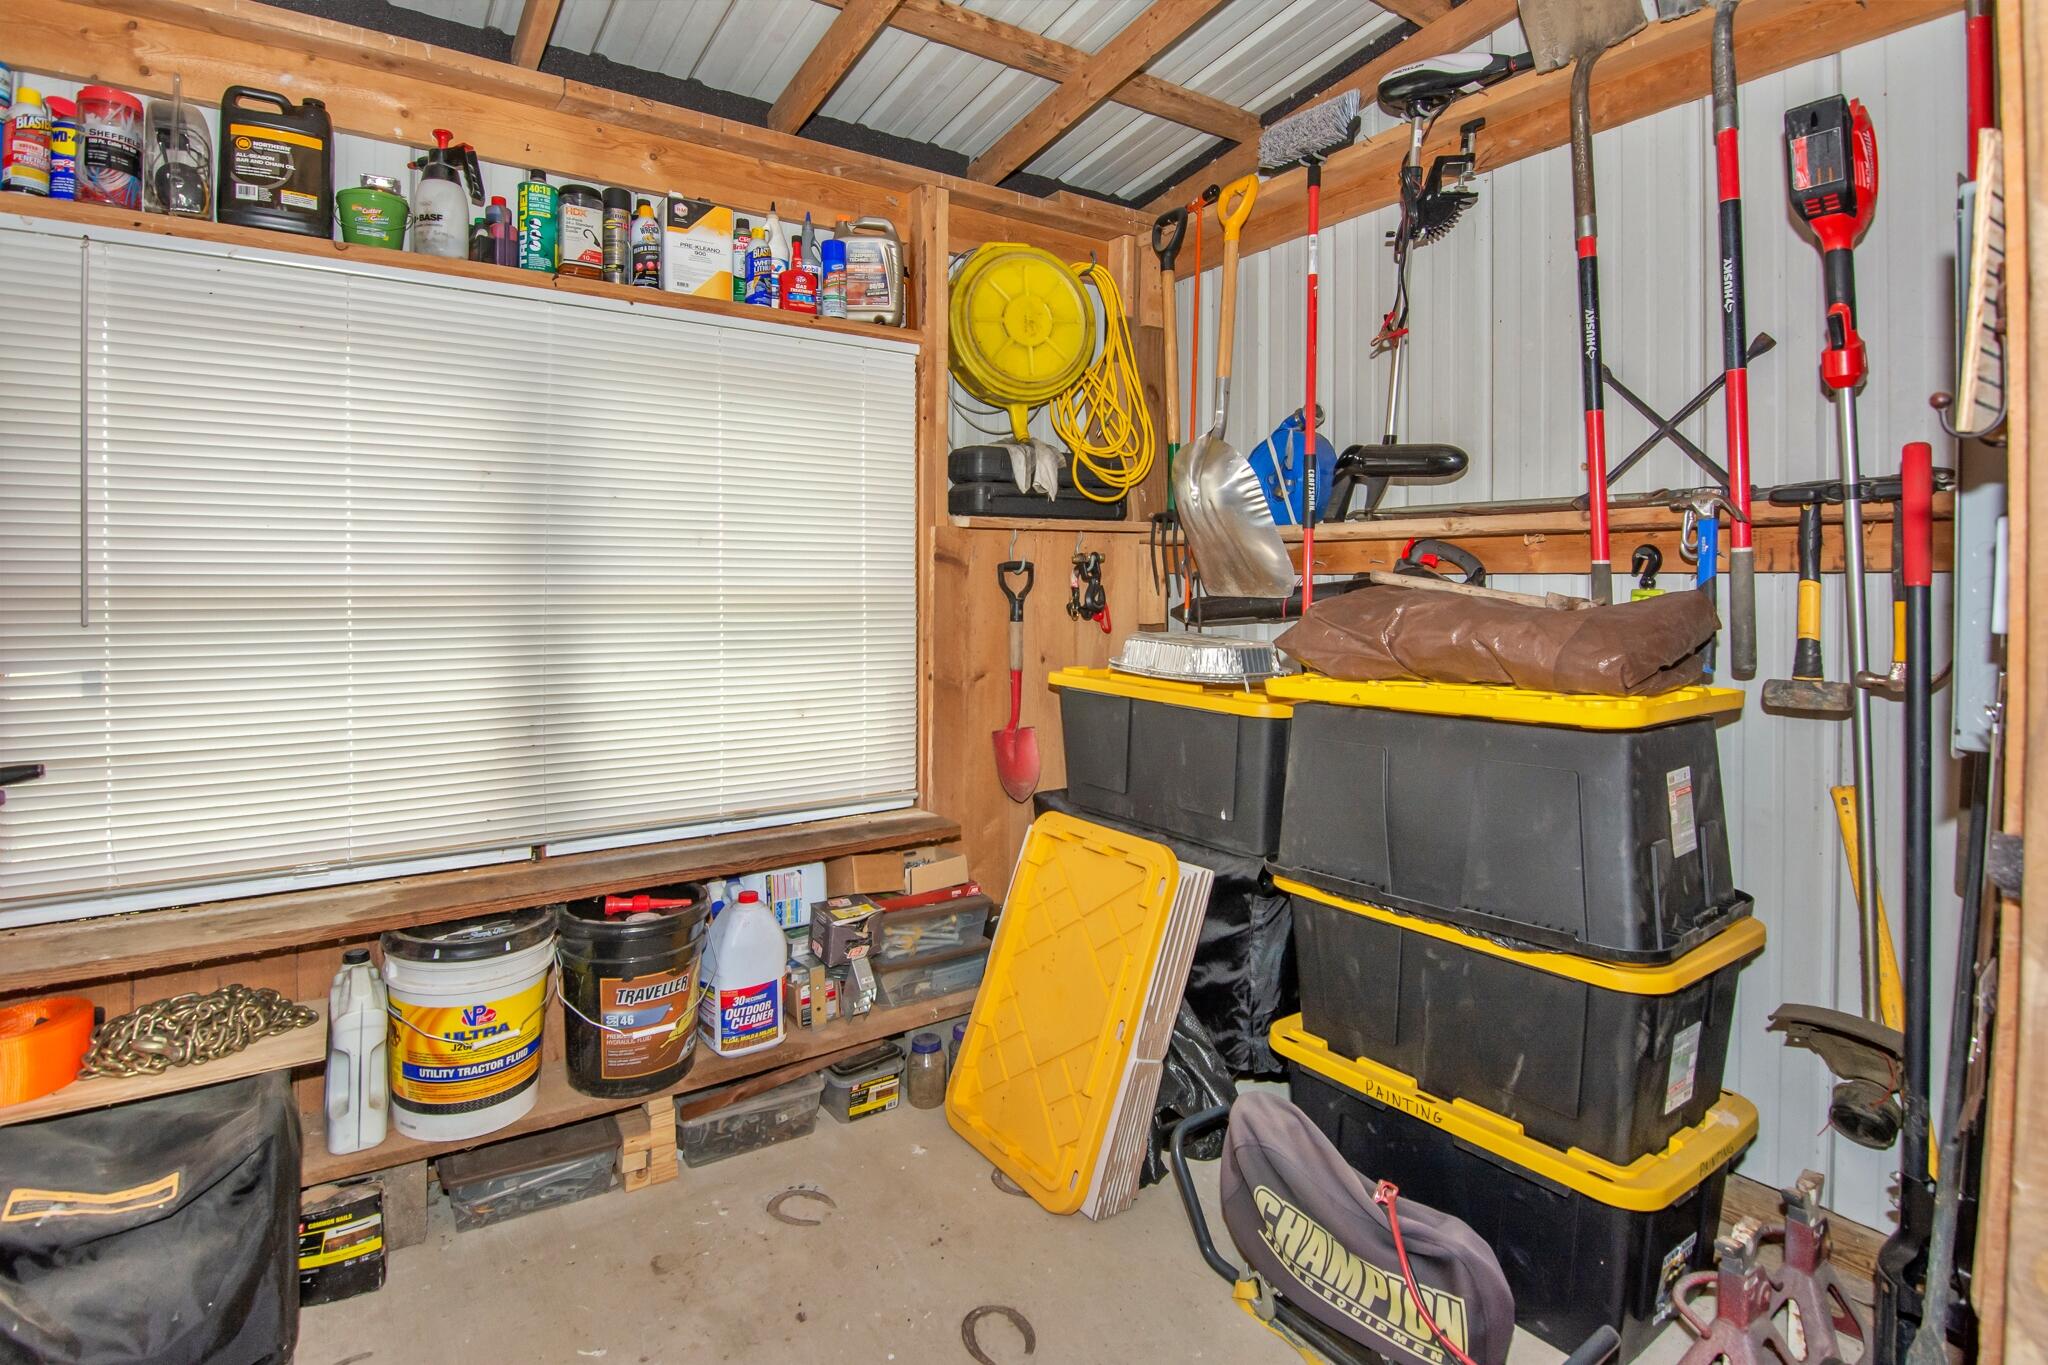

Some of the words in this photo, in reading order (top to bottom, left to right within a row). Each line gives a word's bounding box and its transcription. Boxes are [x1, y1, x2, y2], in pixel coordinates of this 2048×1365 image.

[253, 141, 291, 151] NORTHERN
[419, 214, 444, 222] BASF
[519, 184, 528, 269] TRUFUEL
[1724, 258, 1734, 295] HUSKY
[1585, 309, 1596, 347] HUSKY
[1307, 469, 1316, 512] CRAFTSMAN
[616, 975, 689, 1006] TRAVELLER
[732, 995, 746, 1007] 30
[463, 1005, 487, 1026] VP
[620, 1015, 634, 1026] 46
[725, 1000, 772, 1020] OUTDOOR
[731, 1009, 774, 1030] CLEANER
[444, 1022, 511, 1043] ULTRA
[451, 1042, 479, 1052] J20
[419, 1067, 456, 1078] UTILITY
[457, 1057, 504, 1077] TRACTOR
[505, 1047, 530, 1065] FLUID
[1365, 1079, 1443, 1124] PAINTING
[308, 1218, 335, 1230] COMMON
[335, 1213, 353, 1223] NAILS
[1255, 1187, 1469, 1358] CHAMPION
[1322, 1289, 1446, 1365] EQUIPMEN
